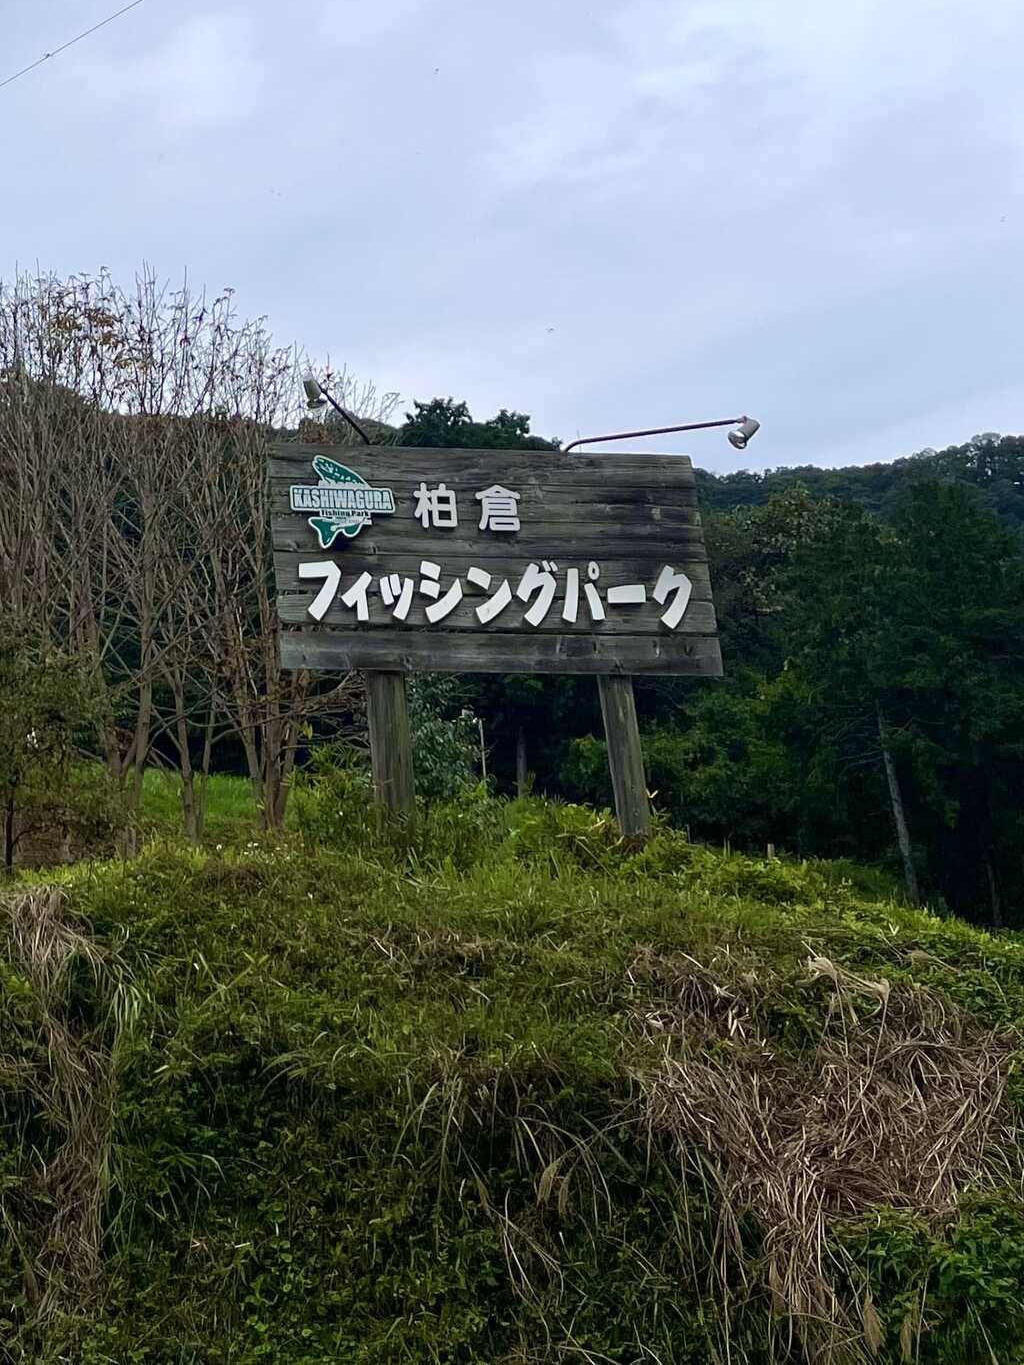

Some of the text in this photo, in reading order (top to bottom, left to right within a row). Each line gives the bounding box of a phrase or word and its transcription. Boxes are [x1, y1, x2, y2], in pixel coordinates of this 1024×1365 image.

[294, 489, 392, 509] KASHIWAGURA
[413, 482, 521, 531] 柏倉
[298, 560, 693, 630] フィッシングパーク
